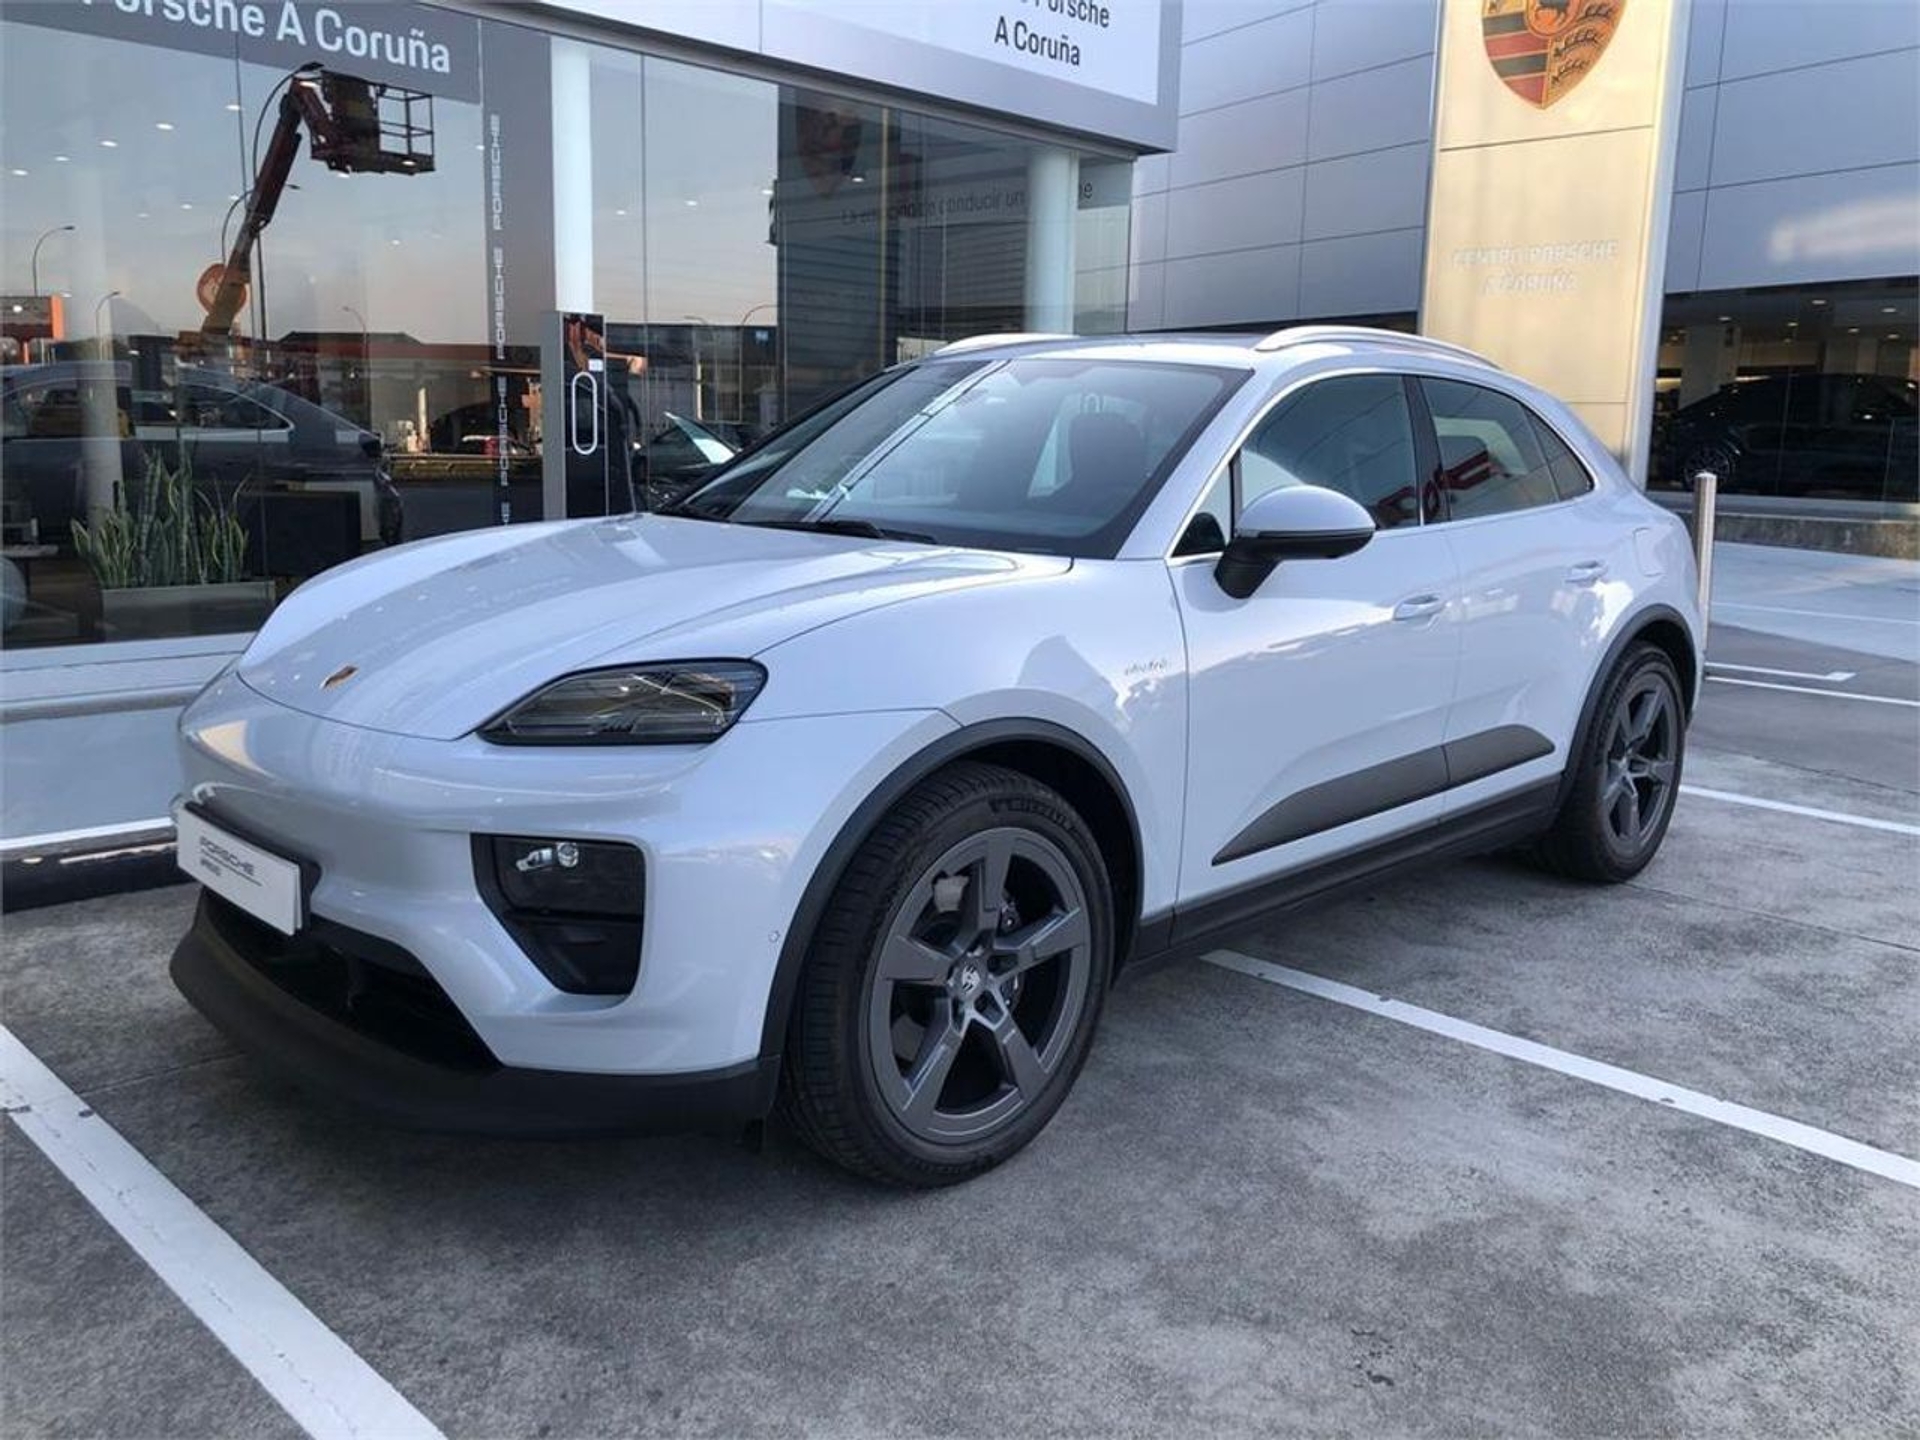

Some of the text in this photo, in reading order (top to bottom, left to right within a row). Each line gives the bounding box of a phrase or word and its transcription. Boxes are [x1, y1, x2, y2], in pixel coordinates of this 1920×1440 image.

[83, 0, 450, 73] orsche A Coruña
[1035, 0, 1109, 28] orsche
[994, 15, 1080, 66] A Coruña
